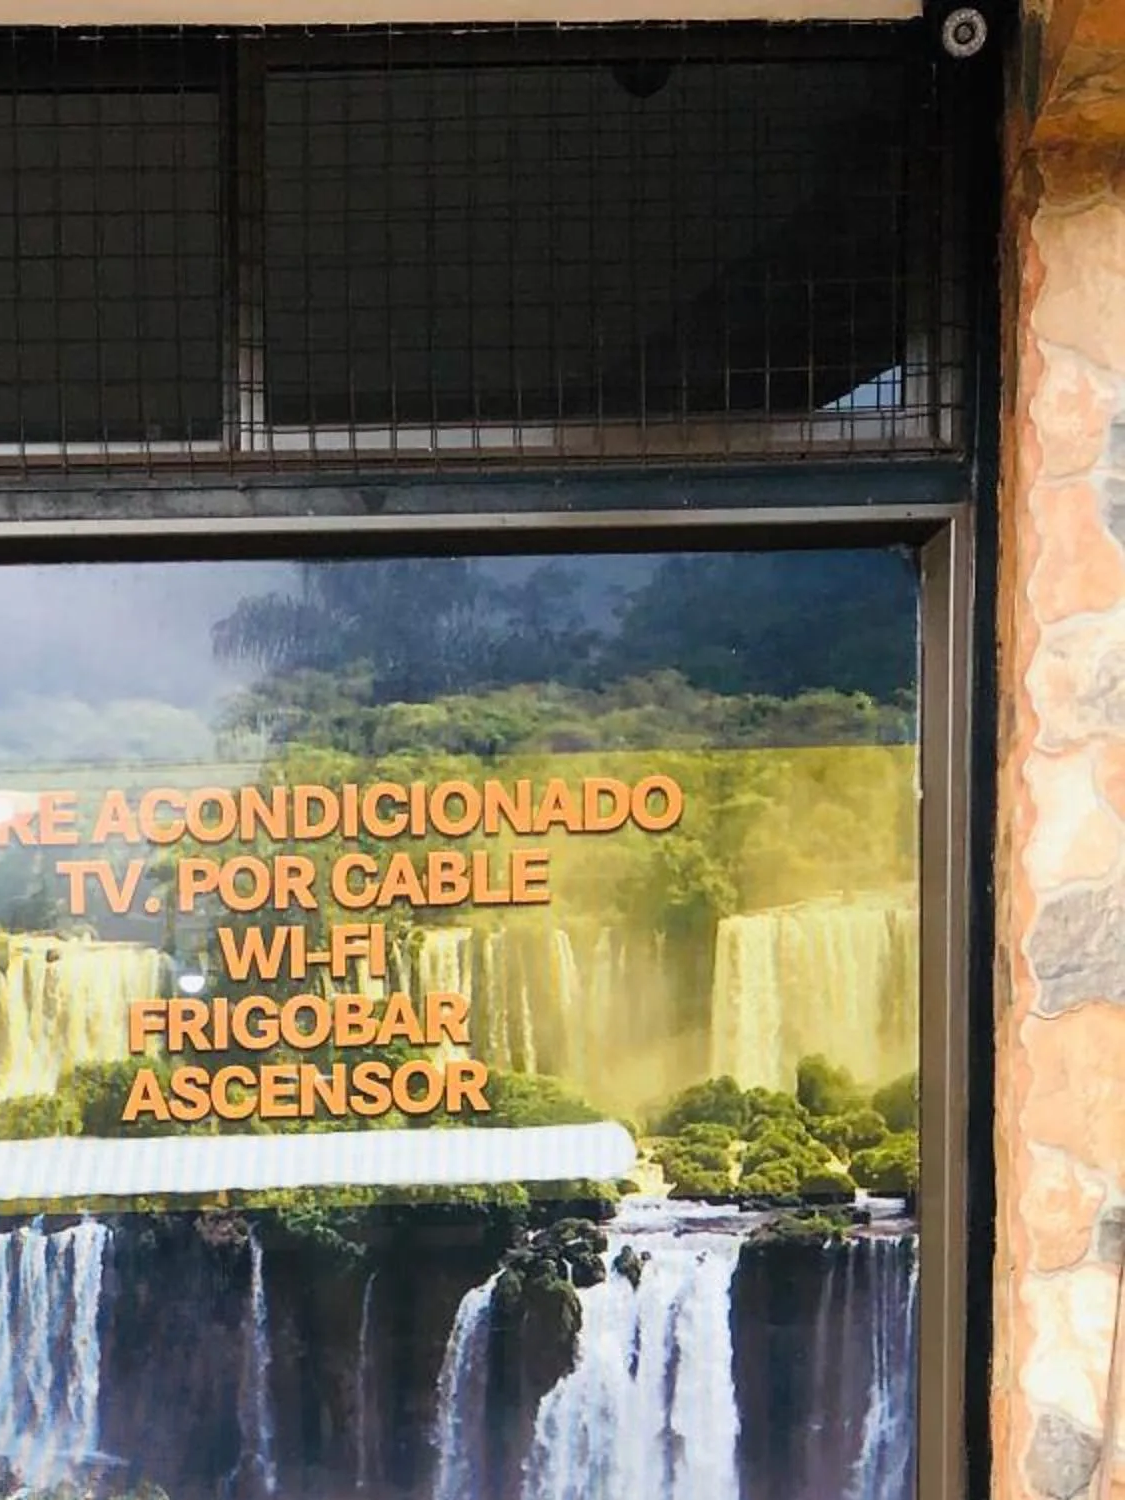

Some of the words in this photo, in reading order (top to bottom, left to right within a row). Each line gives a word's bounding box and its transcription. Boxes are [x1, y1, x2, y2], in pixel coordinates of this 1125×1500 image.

[91, 775, 684, 846] ACONDICIONADO
[55, 857, 163, 916] TV.
[177, 853, 319, 913] POR
[331, 847, 551, 908] CABLE
[217, 922, 388, 982] WI-FI
[128, 990, 471, 1054] FRIGOBAR
[121, 1059, 492, 1122] ASCENSOR
